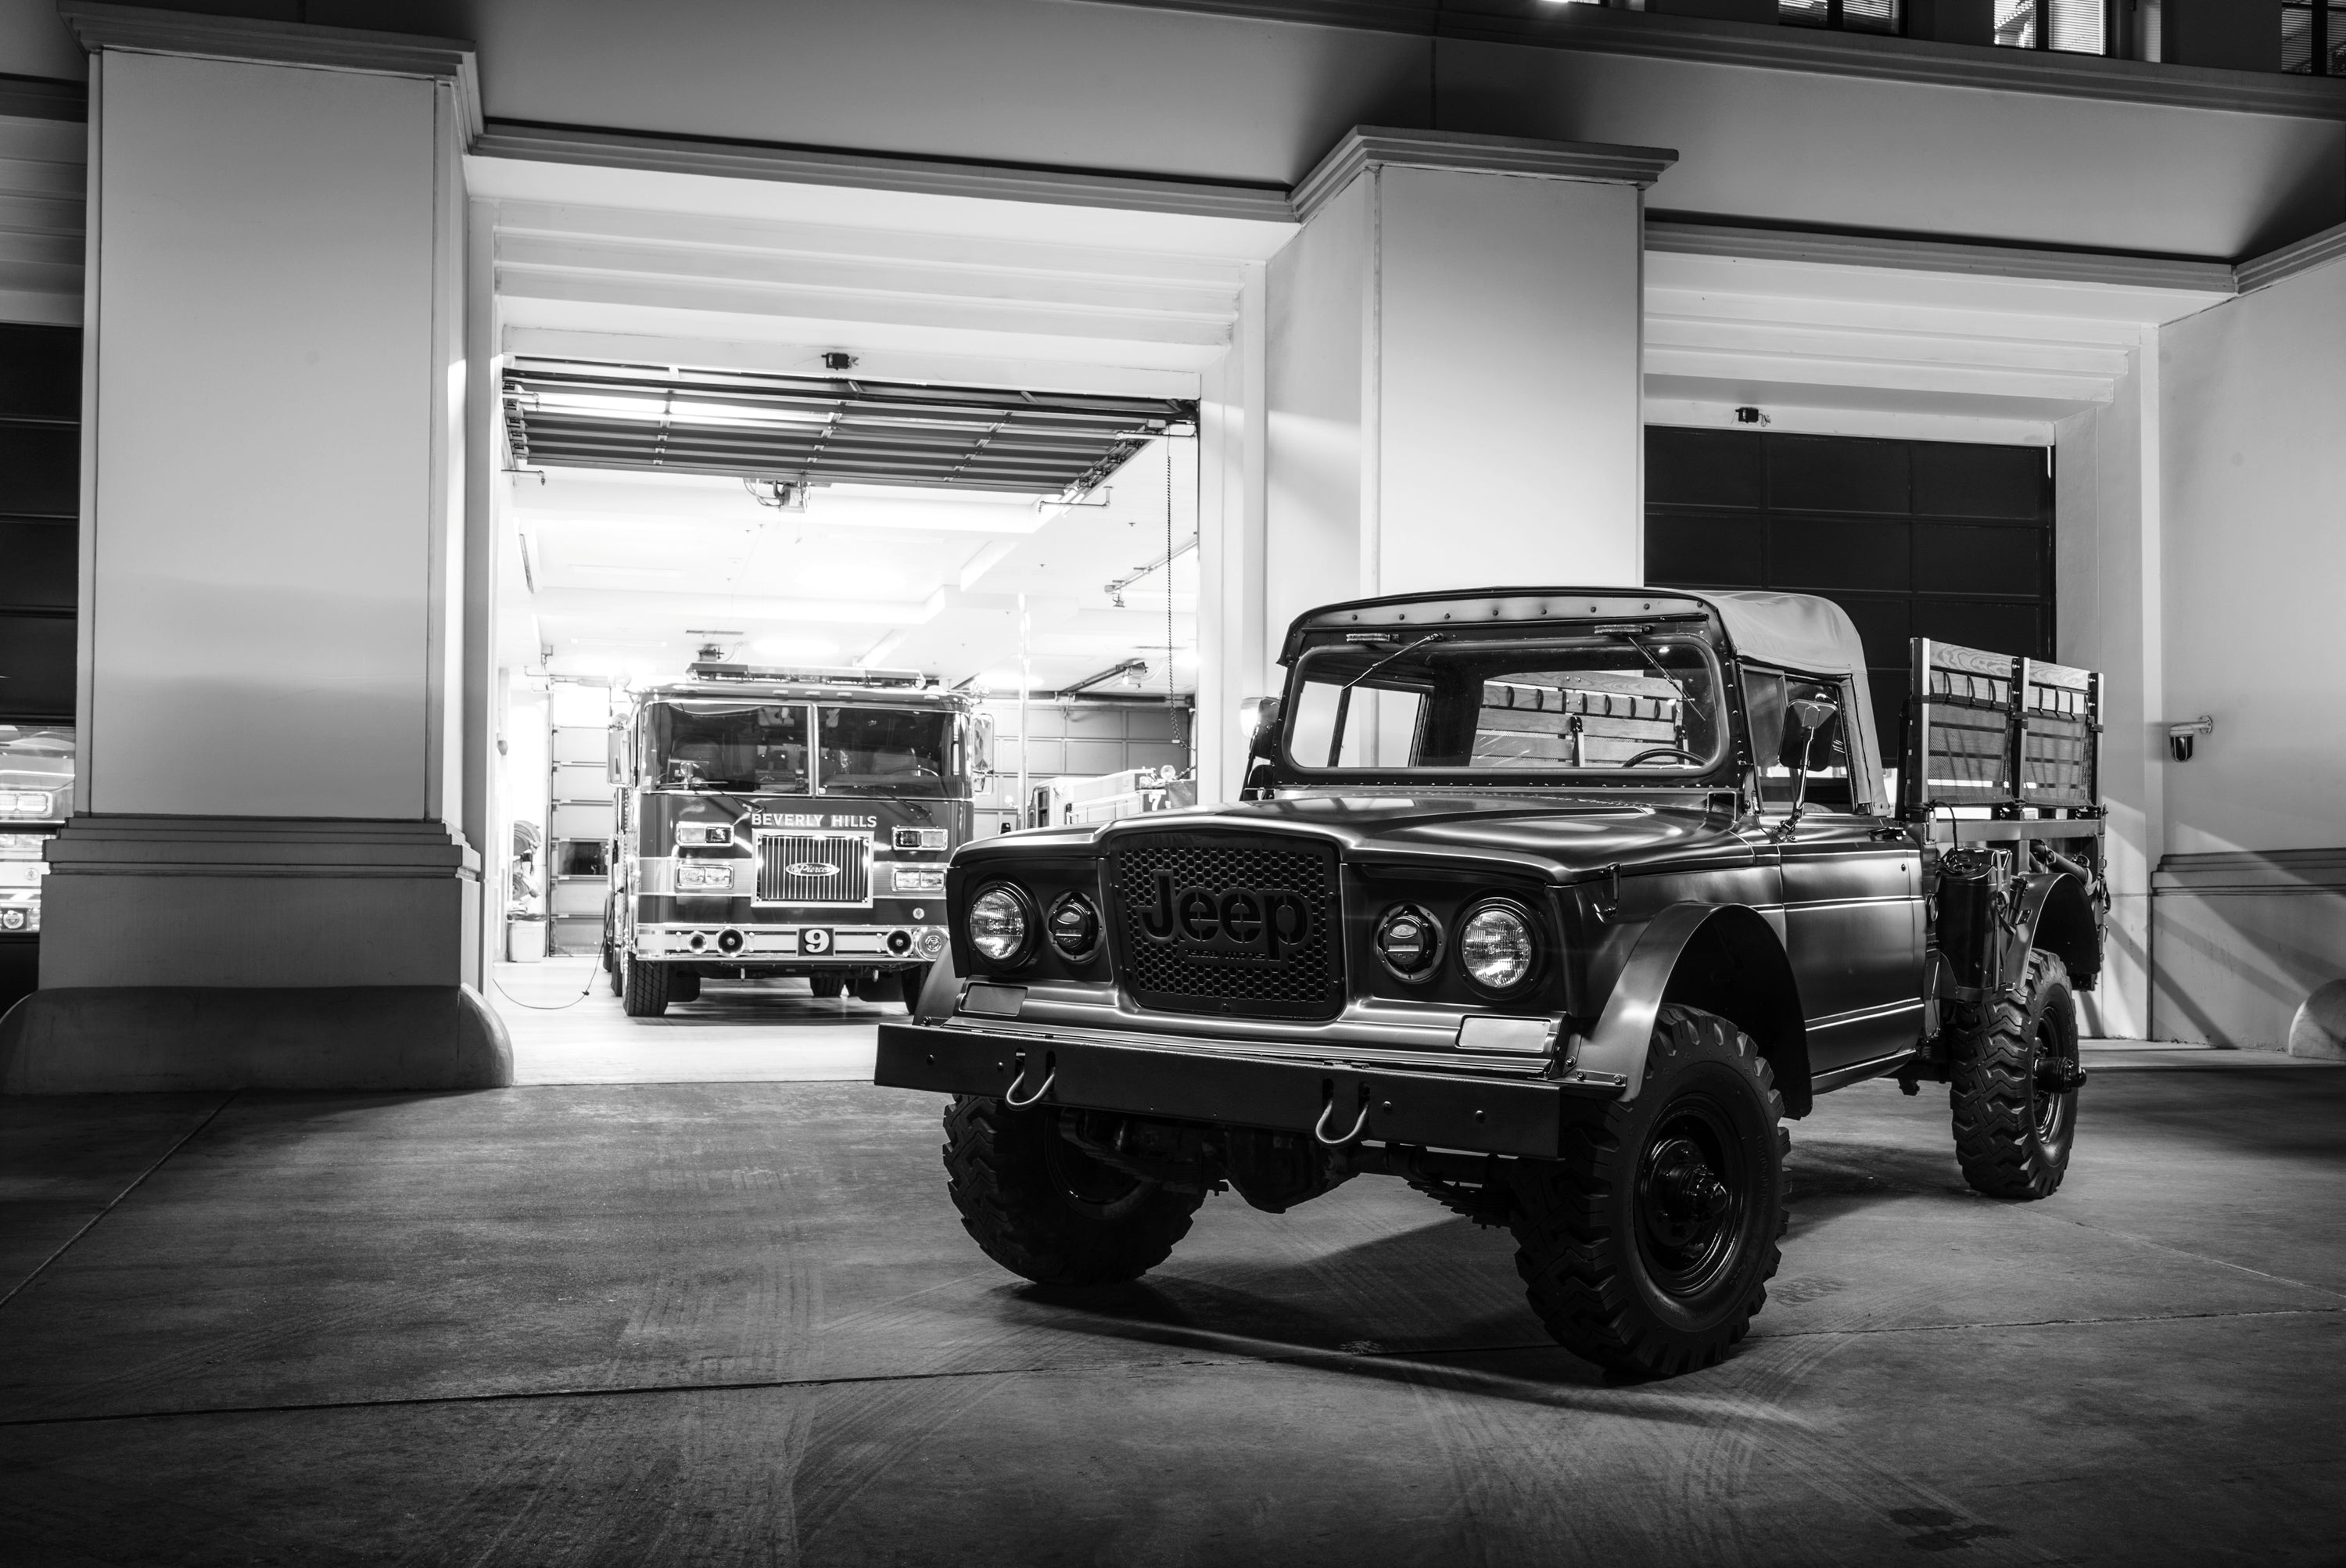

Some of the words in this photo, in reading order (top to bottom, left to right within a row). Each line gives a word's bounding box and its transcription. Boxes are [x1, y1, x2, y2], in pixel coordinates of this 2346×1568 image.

[1148, 791, 1162, 812] 7
[751, 813, 825, 827] BEVERLY
[831, 814, 877, 828] HILLS
[792, 863, 828, 874] Pierce
[1140, 873, 1309, 962] Jeep
[804, 929, 830, 953] 9
